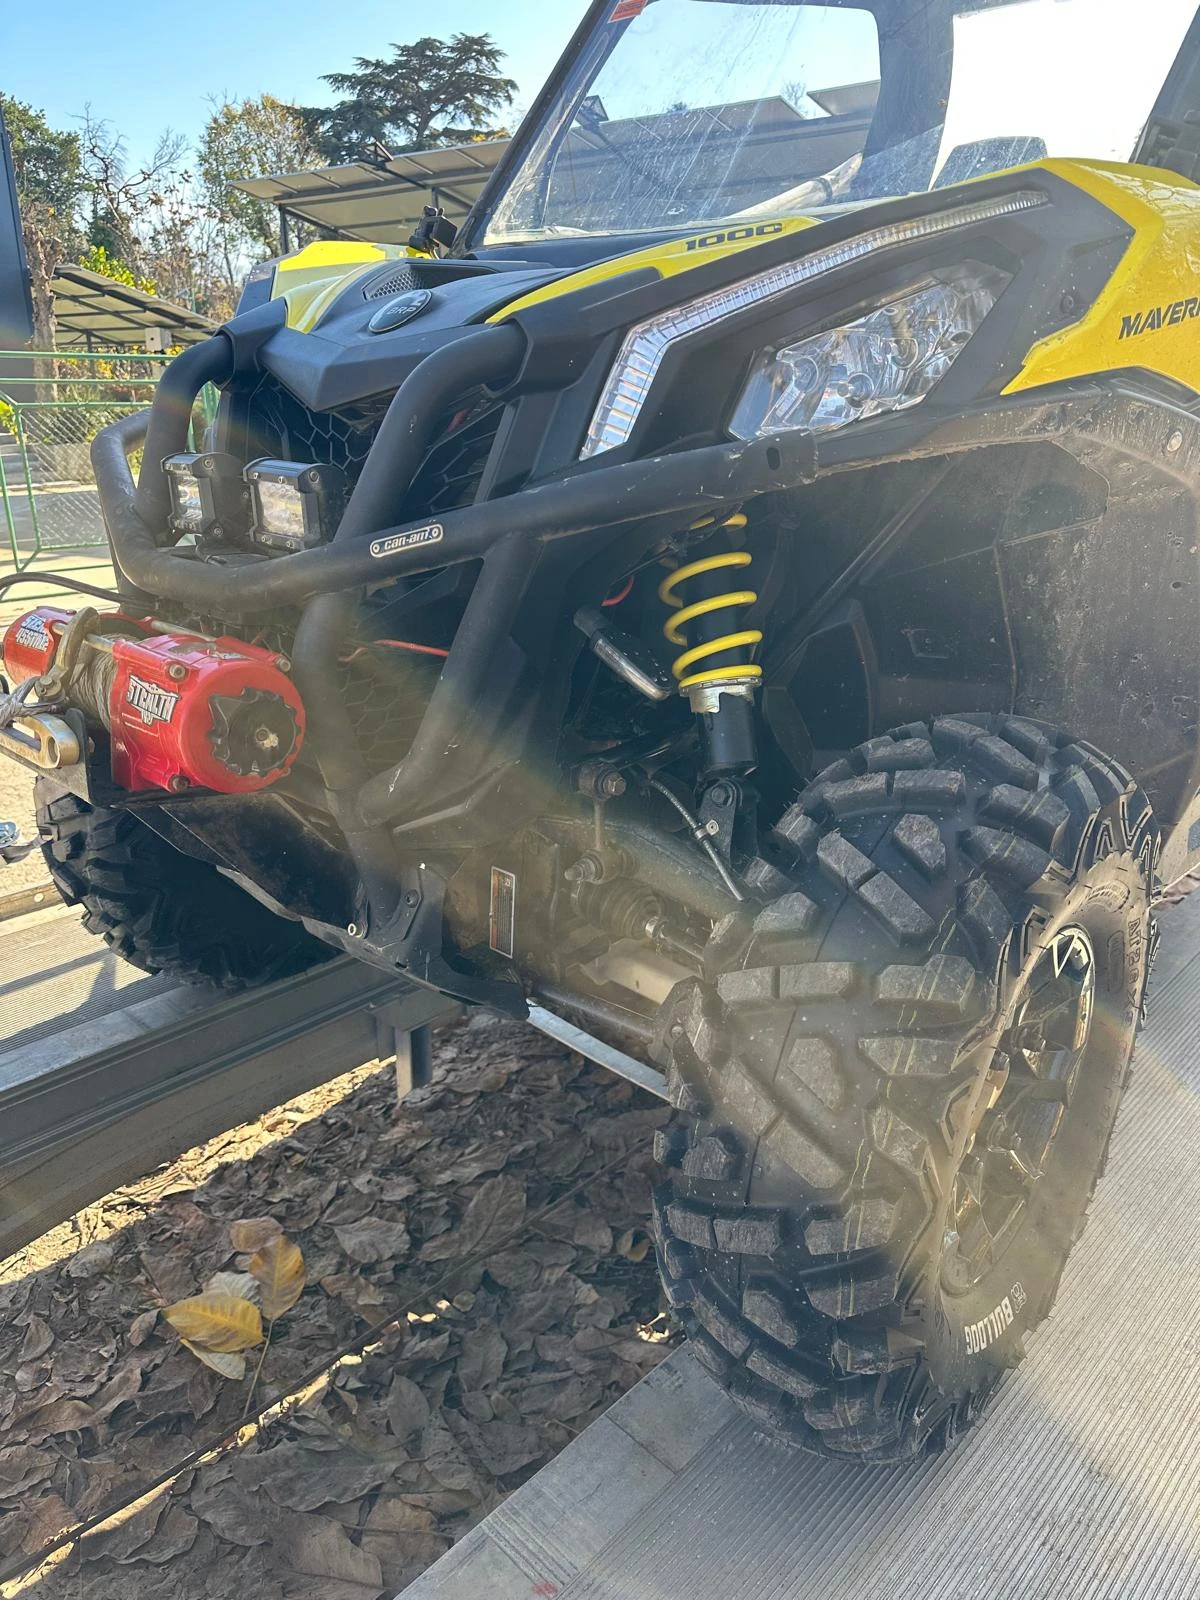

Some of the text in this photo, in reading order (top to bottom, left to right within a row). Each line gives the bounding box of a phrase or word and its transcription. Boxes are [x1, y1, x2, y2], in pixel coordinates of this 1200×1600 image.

[386, 305, 417, 315] BRP
[1118, 296, 1200, 340] MAVER
[384, 529, 429, 551] can-am
[127, 681, 177, 723] STEALTH
[964, 1295, 1014, 1355] BULLDOG
